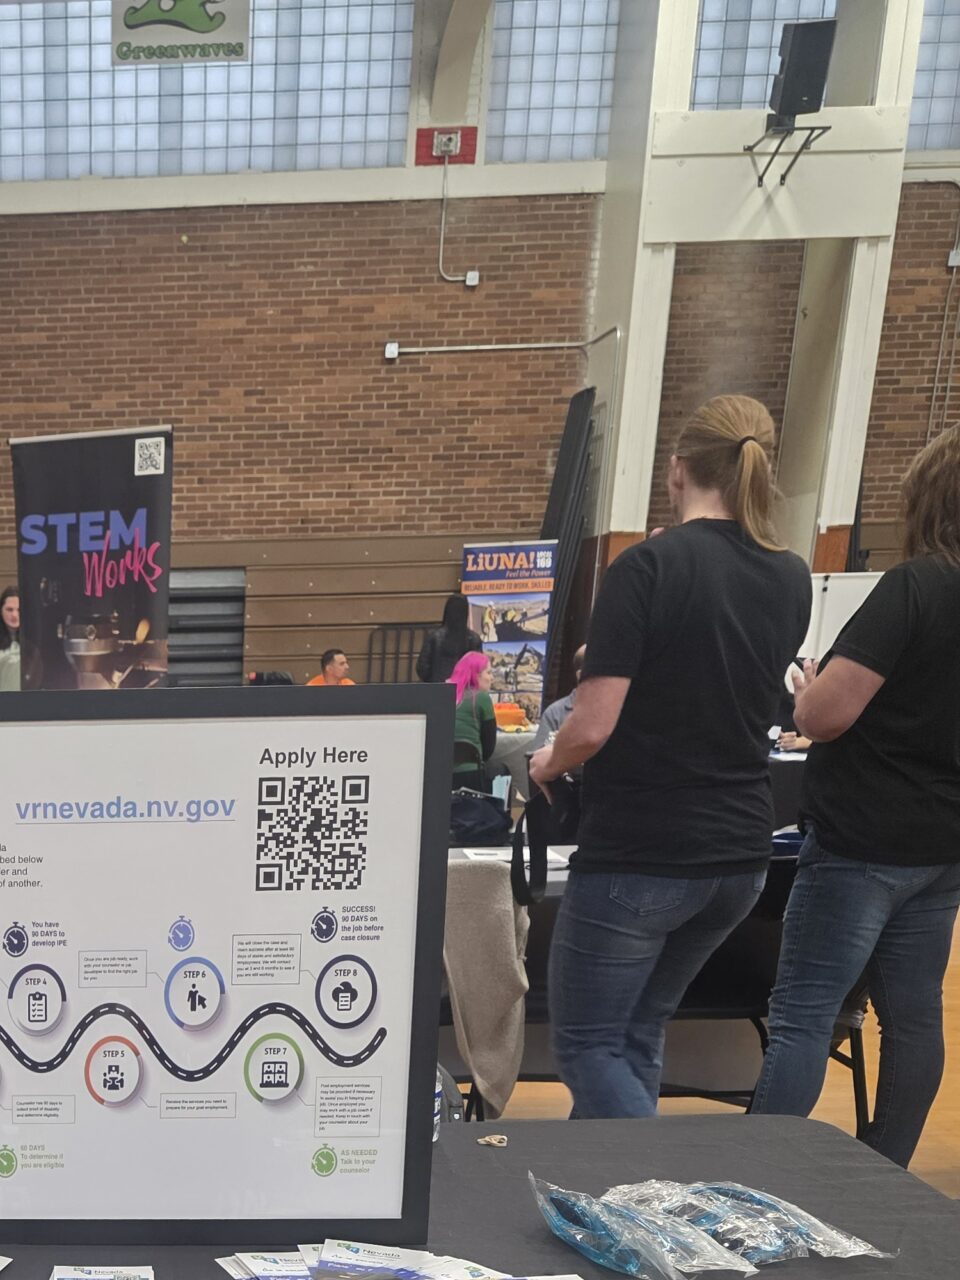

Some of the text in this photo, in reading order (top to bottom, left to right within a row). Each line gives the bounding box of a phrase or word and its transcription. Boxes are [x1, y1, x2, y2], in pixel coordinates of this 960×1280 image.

[116, 42, 244, 60] Greenwaves
[20, 508, 147, 555] STEM
[83, 530, 162, 597] Works
[466, 551, 535, 572] LiUNA!
[505, 570, 519, 578] Feel
[531, 569, 552, 577] Power
[259, 747, 368, 768] Apply Here
[16, 796, 236, 823] vrnevada.nv.gov
[18, 855, 43, 864] below
[11, 867, 28, 876] and
[8, 879, 43, 888] another.
[352, 925, 363, 933] job
[31, 940, 55, 948] develop
[183, 971, 200, 979] STEP
[334, 969, 352, 977] STEP
[43, 1161, 65, 1169] eligible
